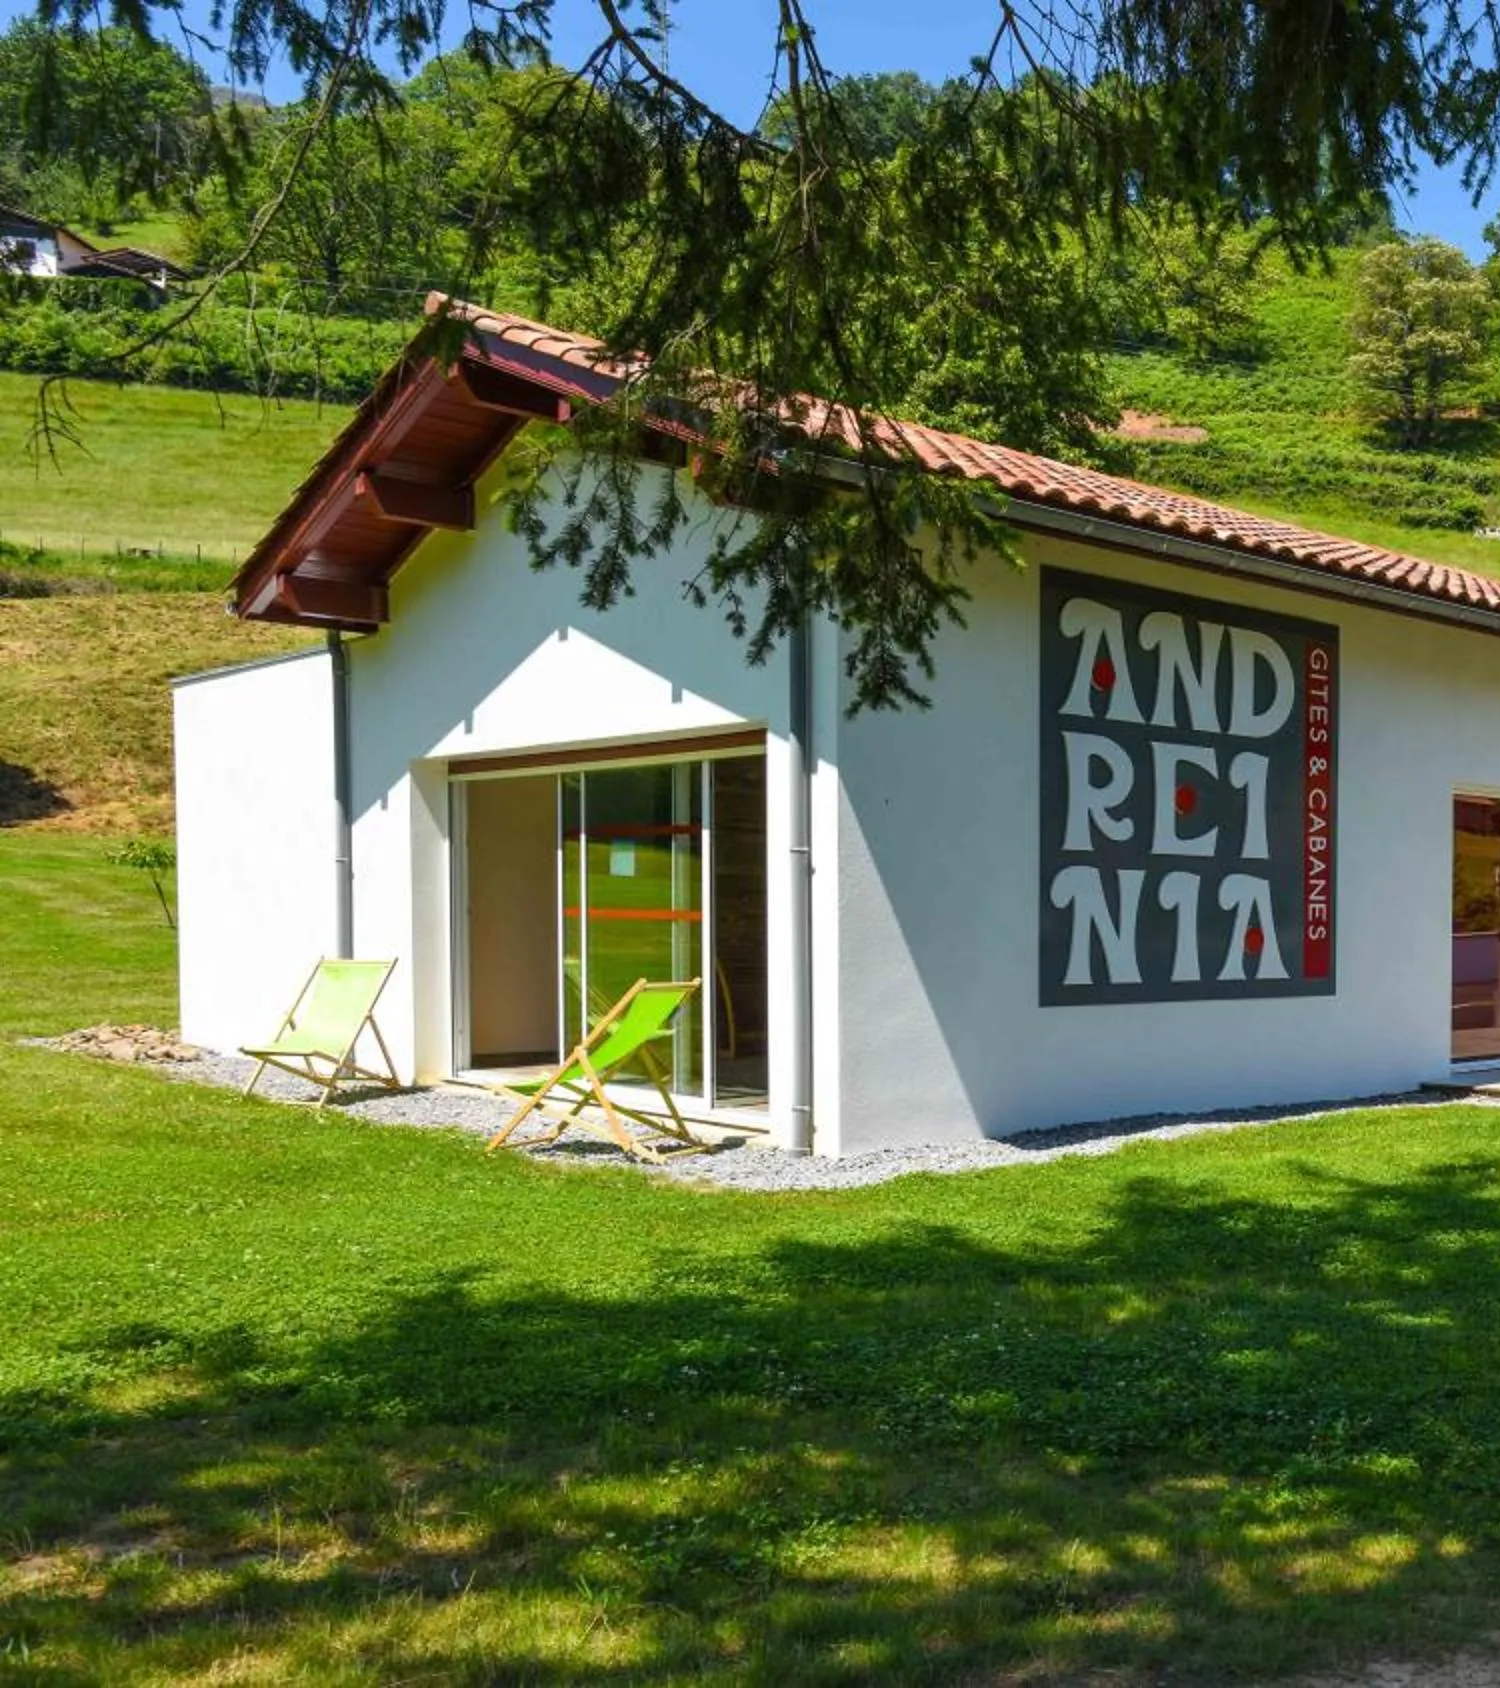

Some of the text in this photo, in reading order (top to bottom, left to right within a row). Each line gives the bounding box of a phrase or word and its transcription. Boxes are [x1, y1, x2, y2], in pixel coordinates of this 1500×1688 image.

[1057, 597, 1295, 739] AND
[1307, 757, 1329, 777] &
[1049, 864, 1292, 986] NIA
[1307, 788, 1329, 942] CABANES
